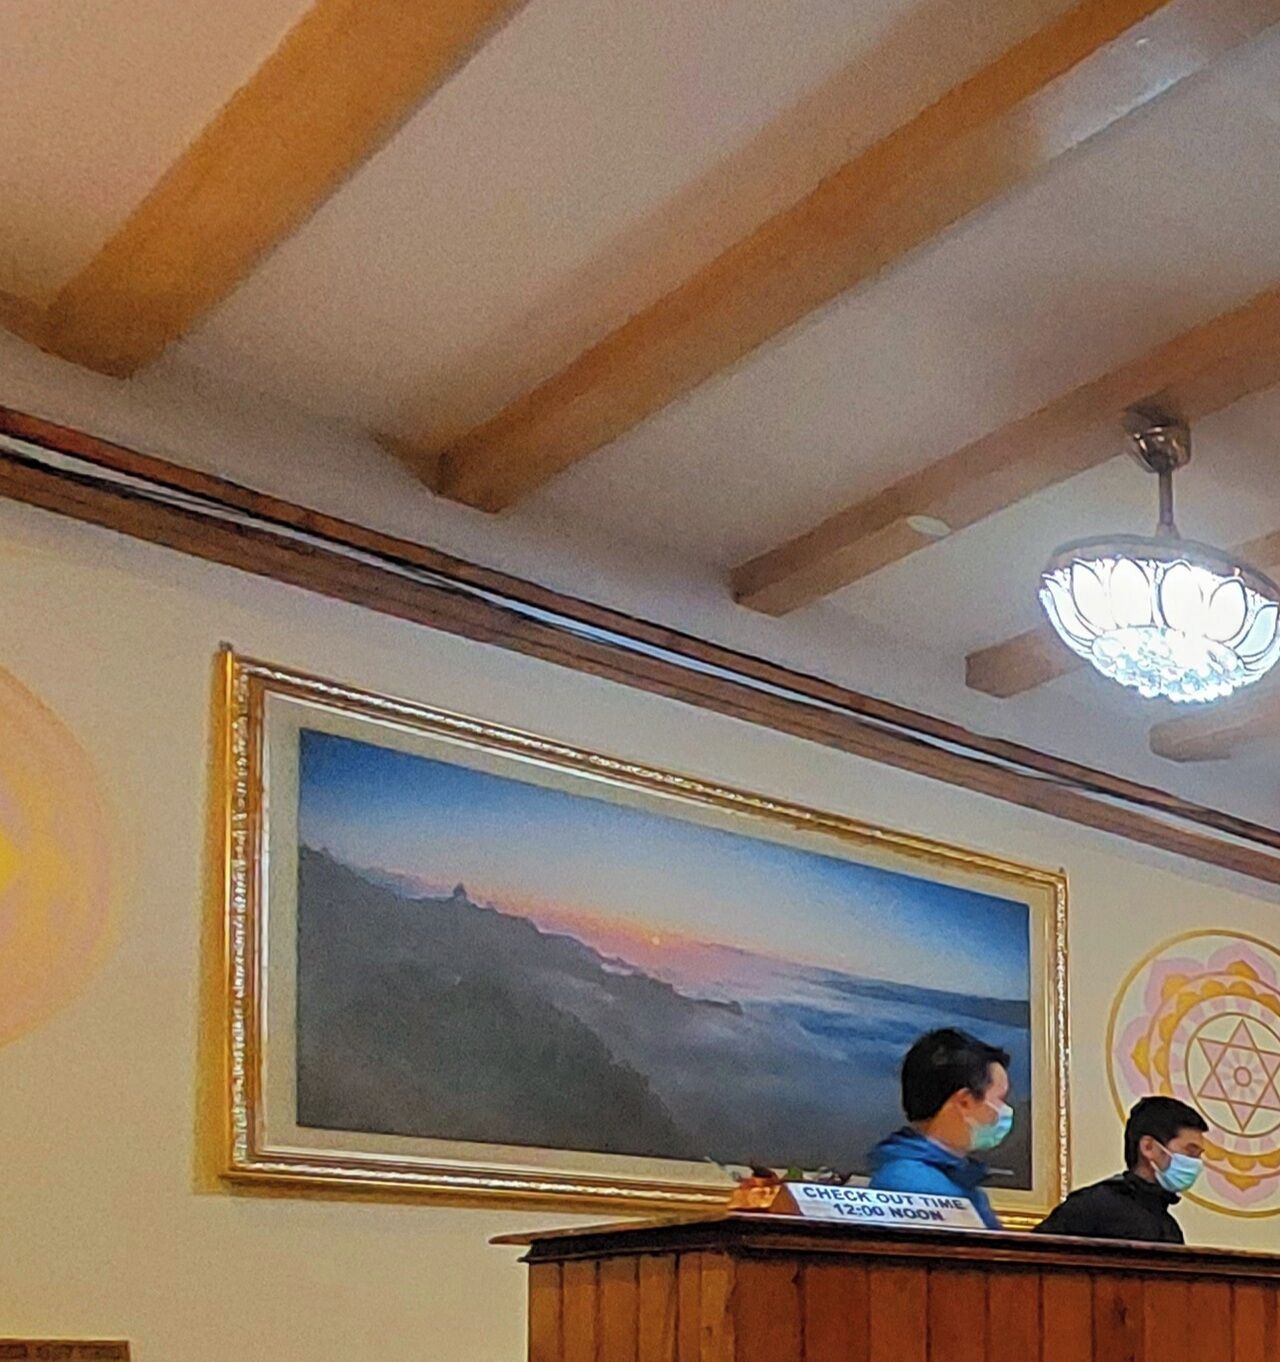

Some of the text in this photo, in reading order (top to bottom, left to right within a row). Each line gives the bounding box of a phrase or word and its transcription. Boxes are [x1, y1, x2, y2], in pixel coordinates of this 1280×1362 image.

[802, 1186, 966, 1211] CHECK OUT TIME
[833, 1203, 944, 1221] 12:00 NOON
